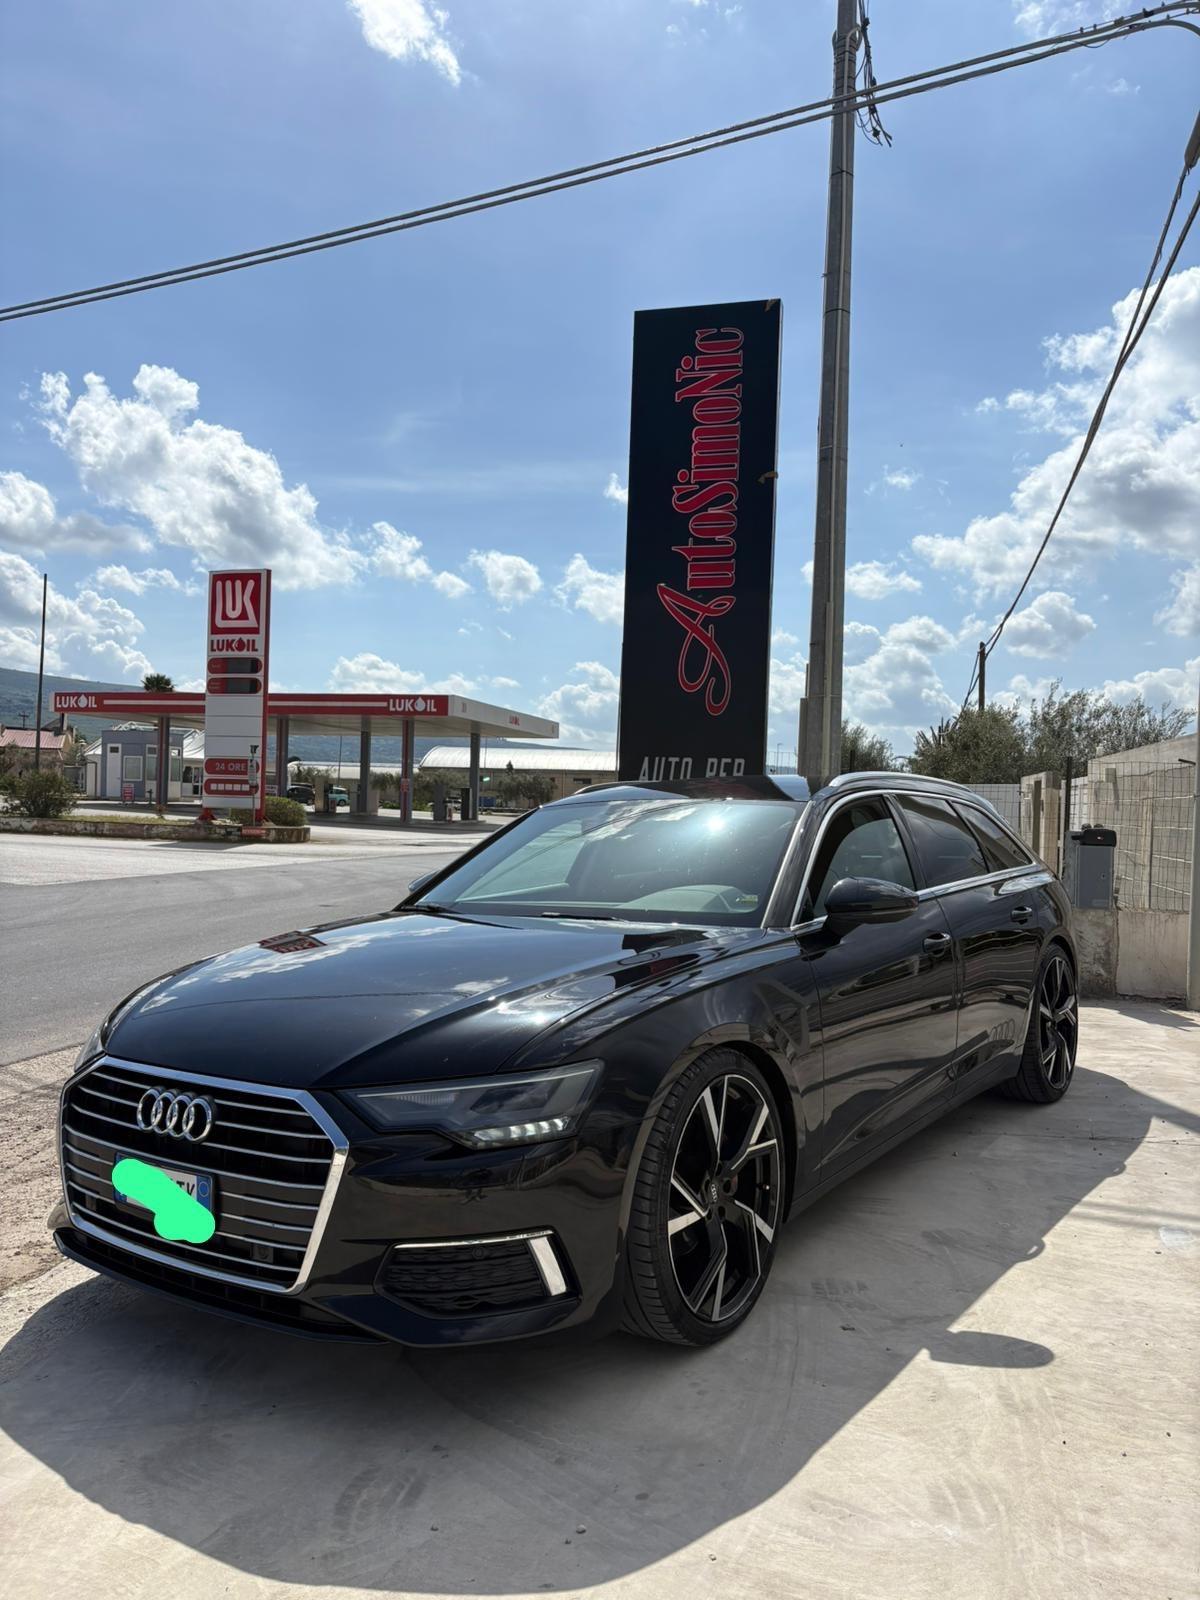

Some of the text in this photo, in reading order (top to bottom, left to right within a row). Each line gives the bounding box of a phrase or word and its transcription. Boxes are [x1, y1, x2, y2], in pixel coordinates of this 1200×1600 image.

[657, 327, 744, 716] AutoSimoNic
[210, 637, 259, 652] LUKOIL
[56, 694, 97, 709] LUKOIL
[389, 697, 437, 712] LUKOIL
[215, 762, 247, 771] 24 ORE
[638, 756, 693, 781] AUTO
